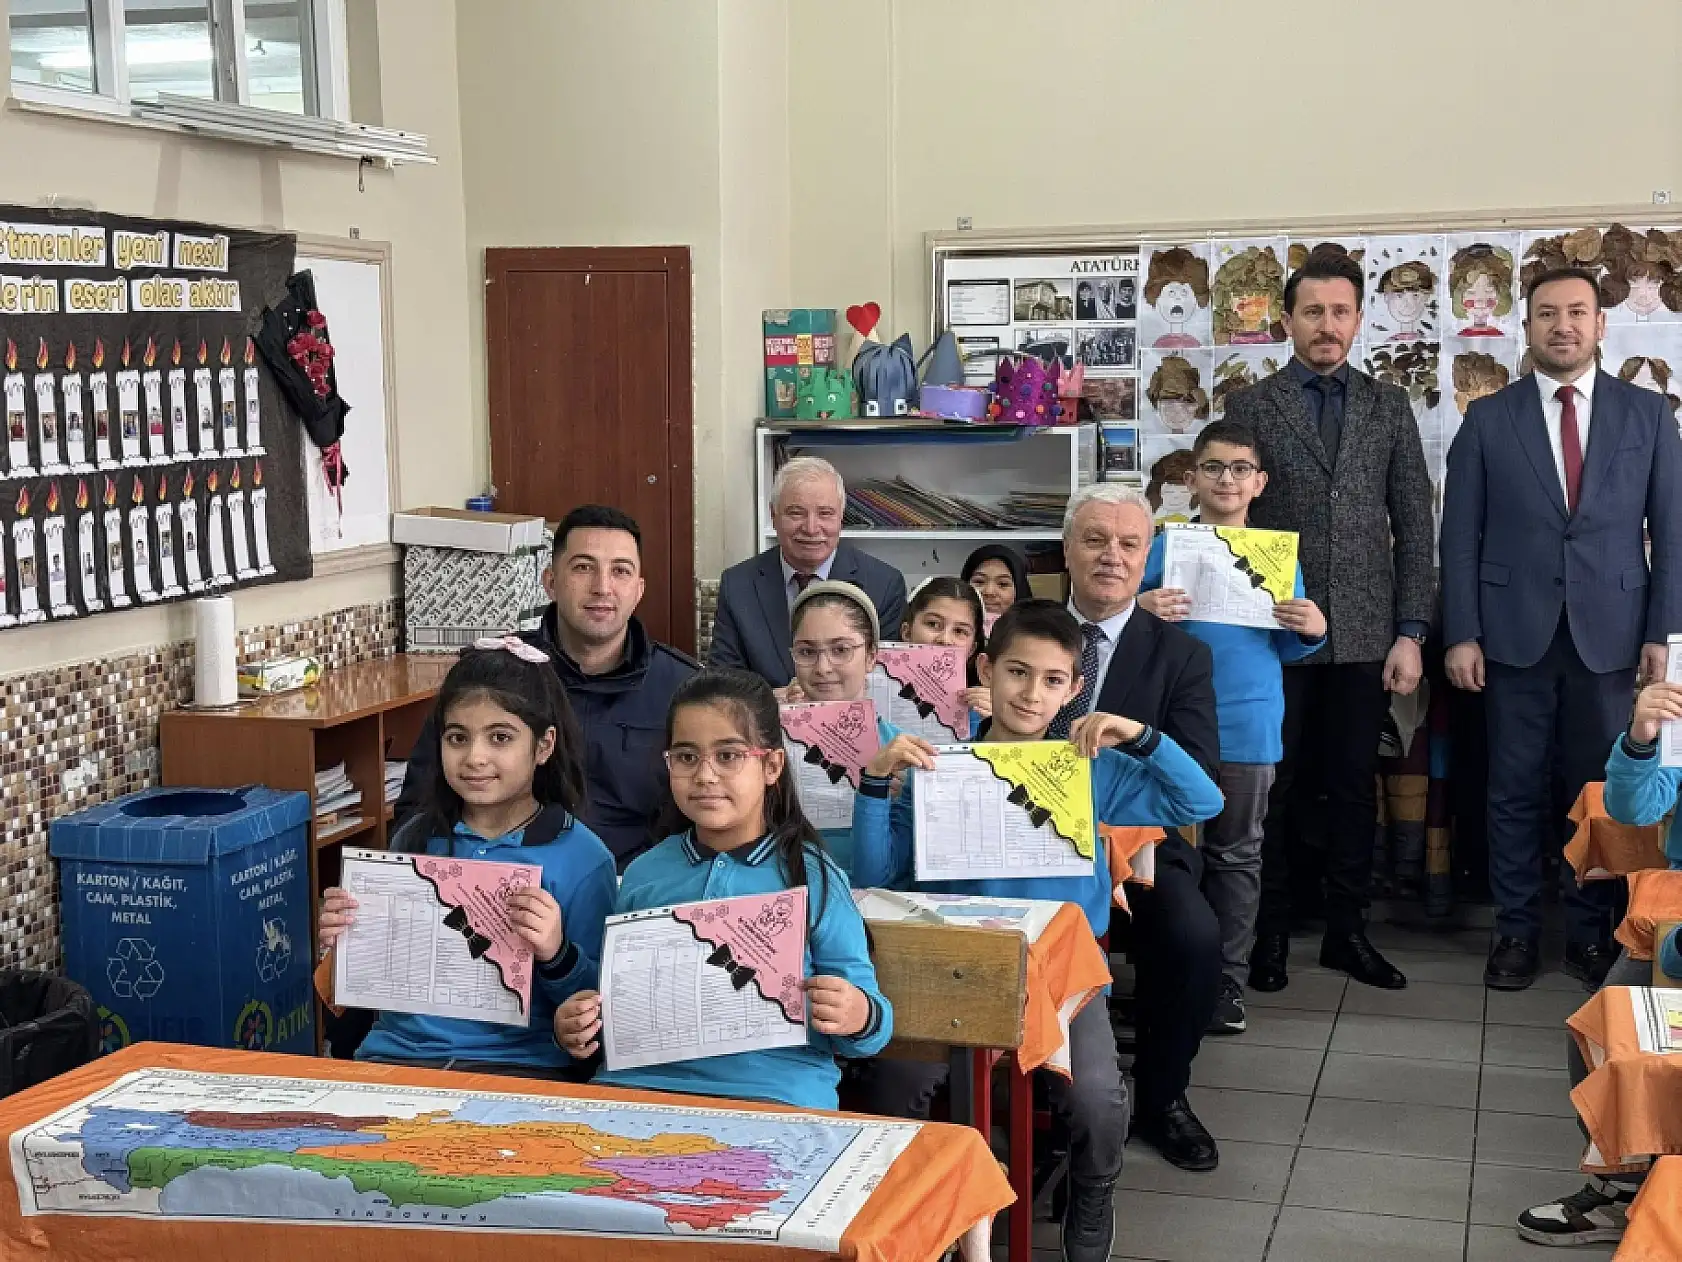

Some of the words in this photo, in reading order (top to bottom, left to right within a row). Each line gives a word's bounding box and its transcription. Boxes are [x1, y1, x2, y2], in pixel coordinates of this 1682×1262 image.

[117, 229, 165, 271] yeni
[178, 233, 226, 268] nesil
[70, 275, 125, 311] eseri
[77, 873, 129, 888] KARTON
[143, 876, 188, 892] KAĞIT,
[86, 892, 118, 907] CAM,
[121, 892, 177, 909] PLASTİK,
[112, 911, 151, 924] METAL
